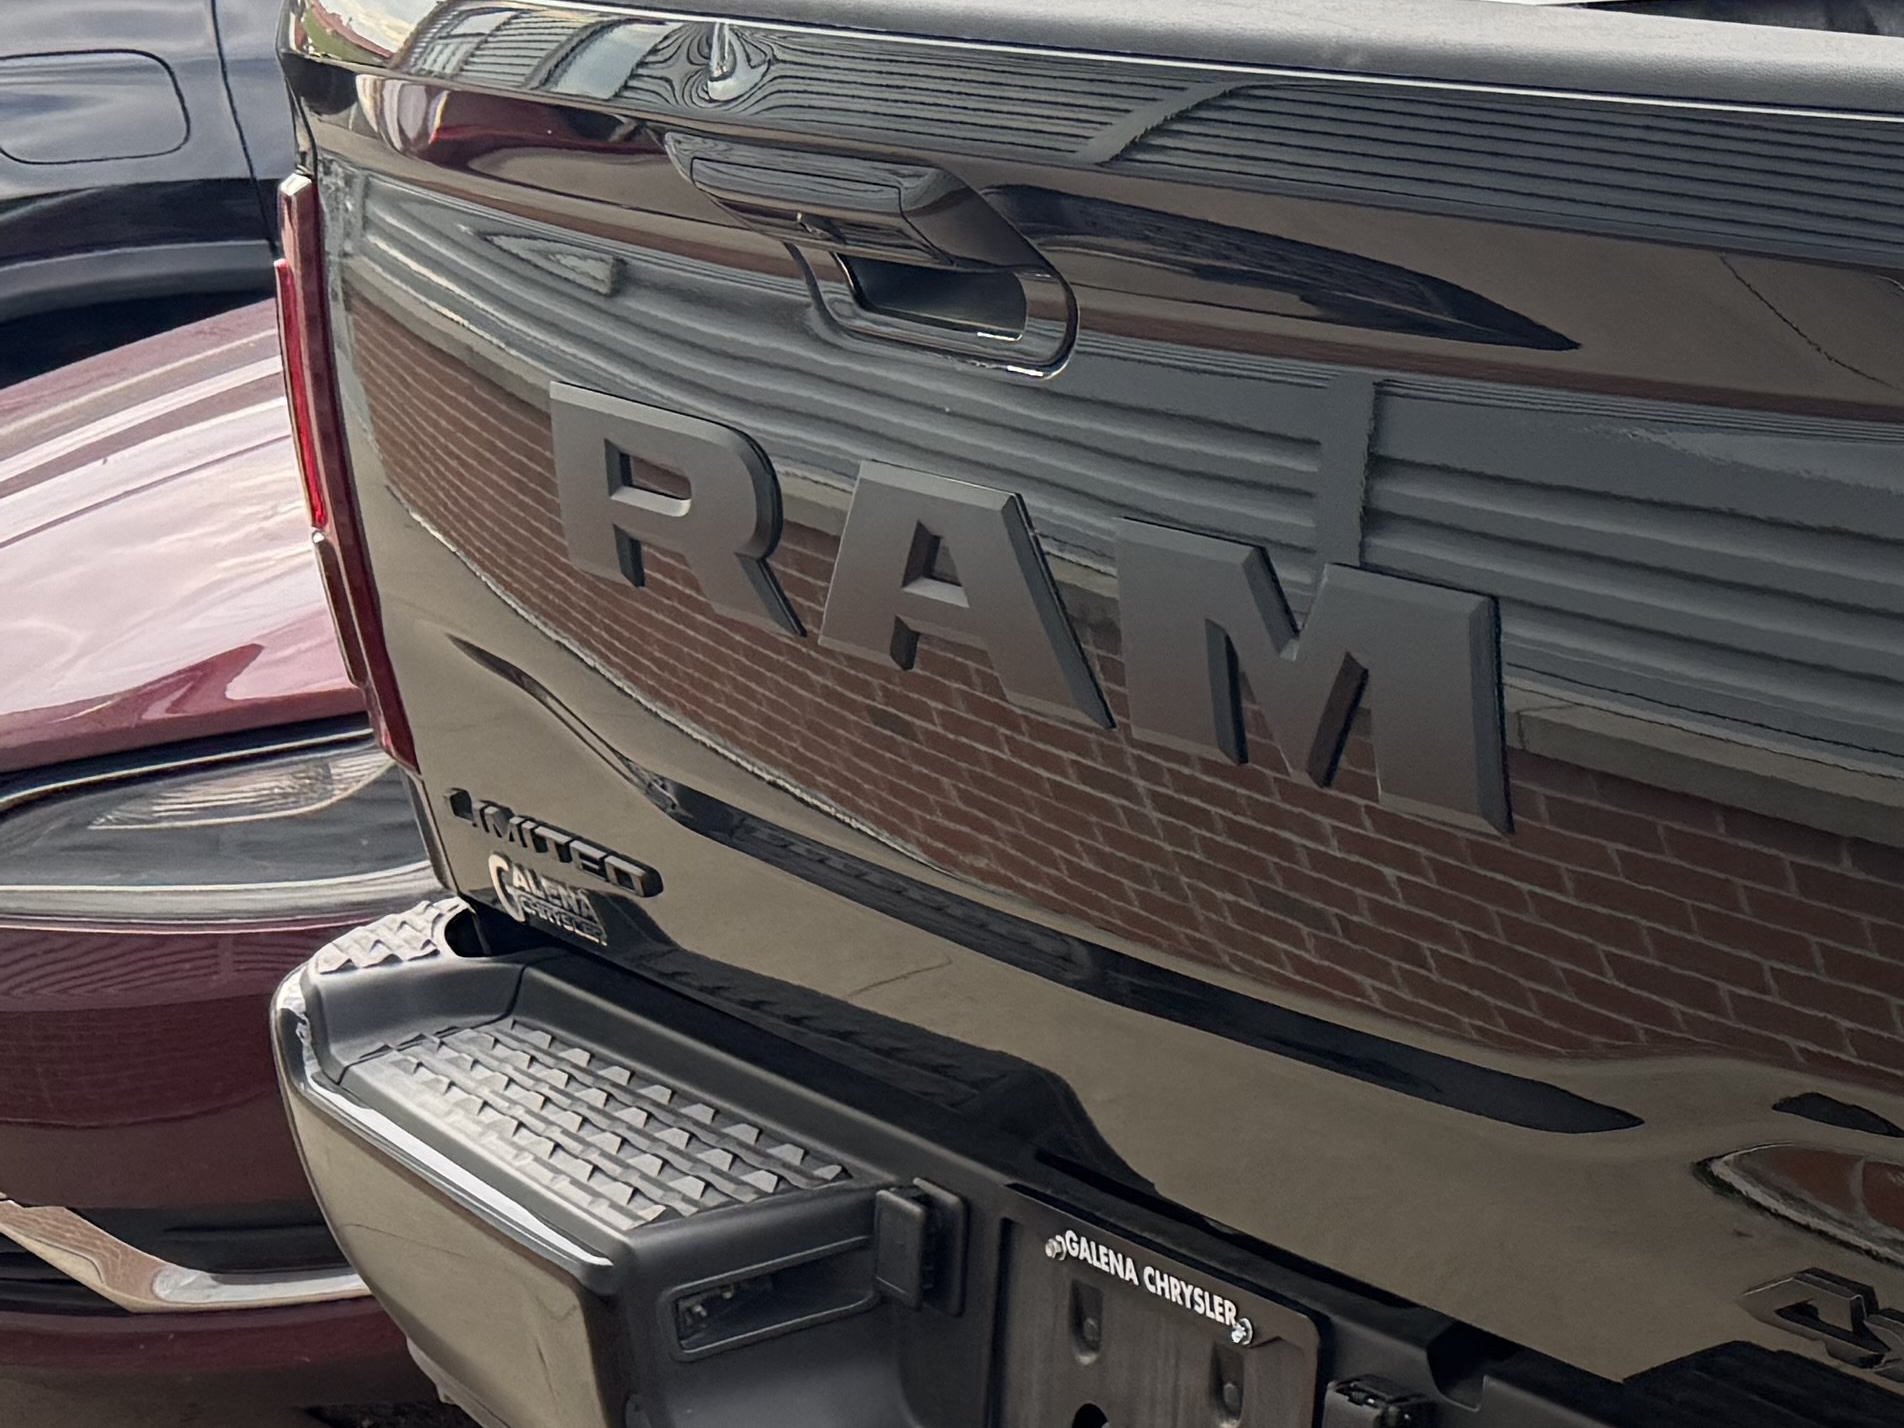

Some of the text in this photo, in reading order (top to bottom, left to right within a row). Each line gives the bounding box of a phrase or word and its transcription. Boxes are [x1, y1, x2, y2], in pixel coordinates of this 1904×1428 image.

[550, 380, 1515, 835] RAM
[488, 852, 602, 924] GALENA
[1064, 1228, 1238, 1328] GALENA CHRYSLER
